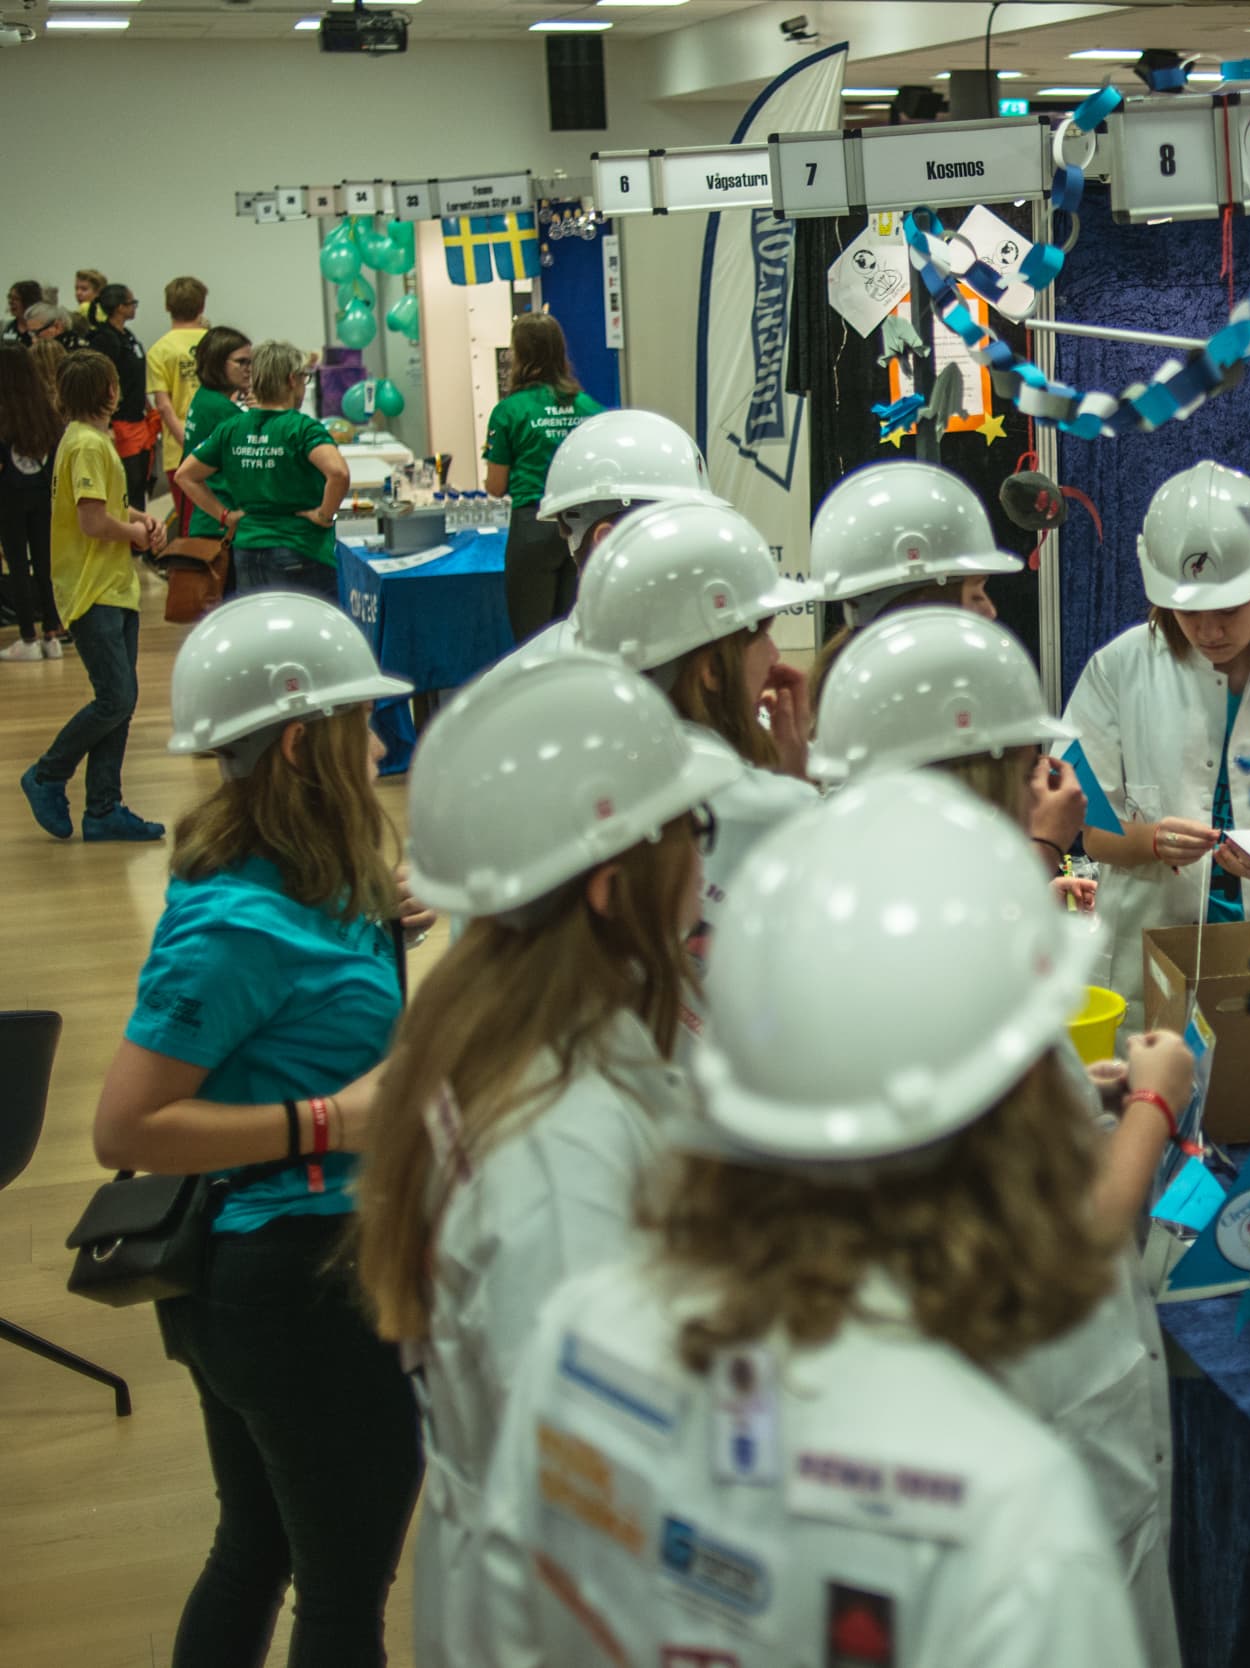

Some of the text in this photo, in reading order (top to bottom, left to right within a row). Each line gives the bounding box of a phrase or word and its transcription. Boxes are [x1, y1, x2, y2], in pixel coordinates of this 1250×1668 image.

[1159, 144, 1177, 177] 8
[805, 163, 817, 186] 7
[926, 161, 985, 180] Kosmos
[472, 186, 493, 196] Team
[620, 175, 629, 193] 6
[706, 173, 768, 191] Vågsaturn
[544, 405, 575, 416] TEAM
